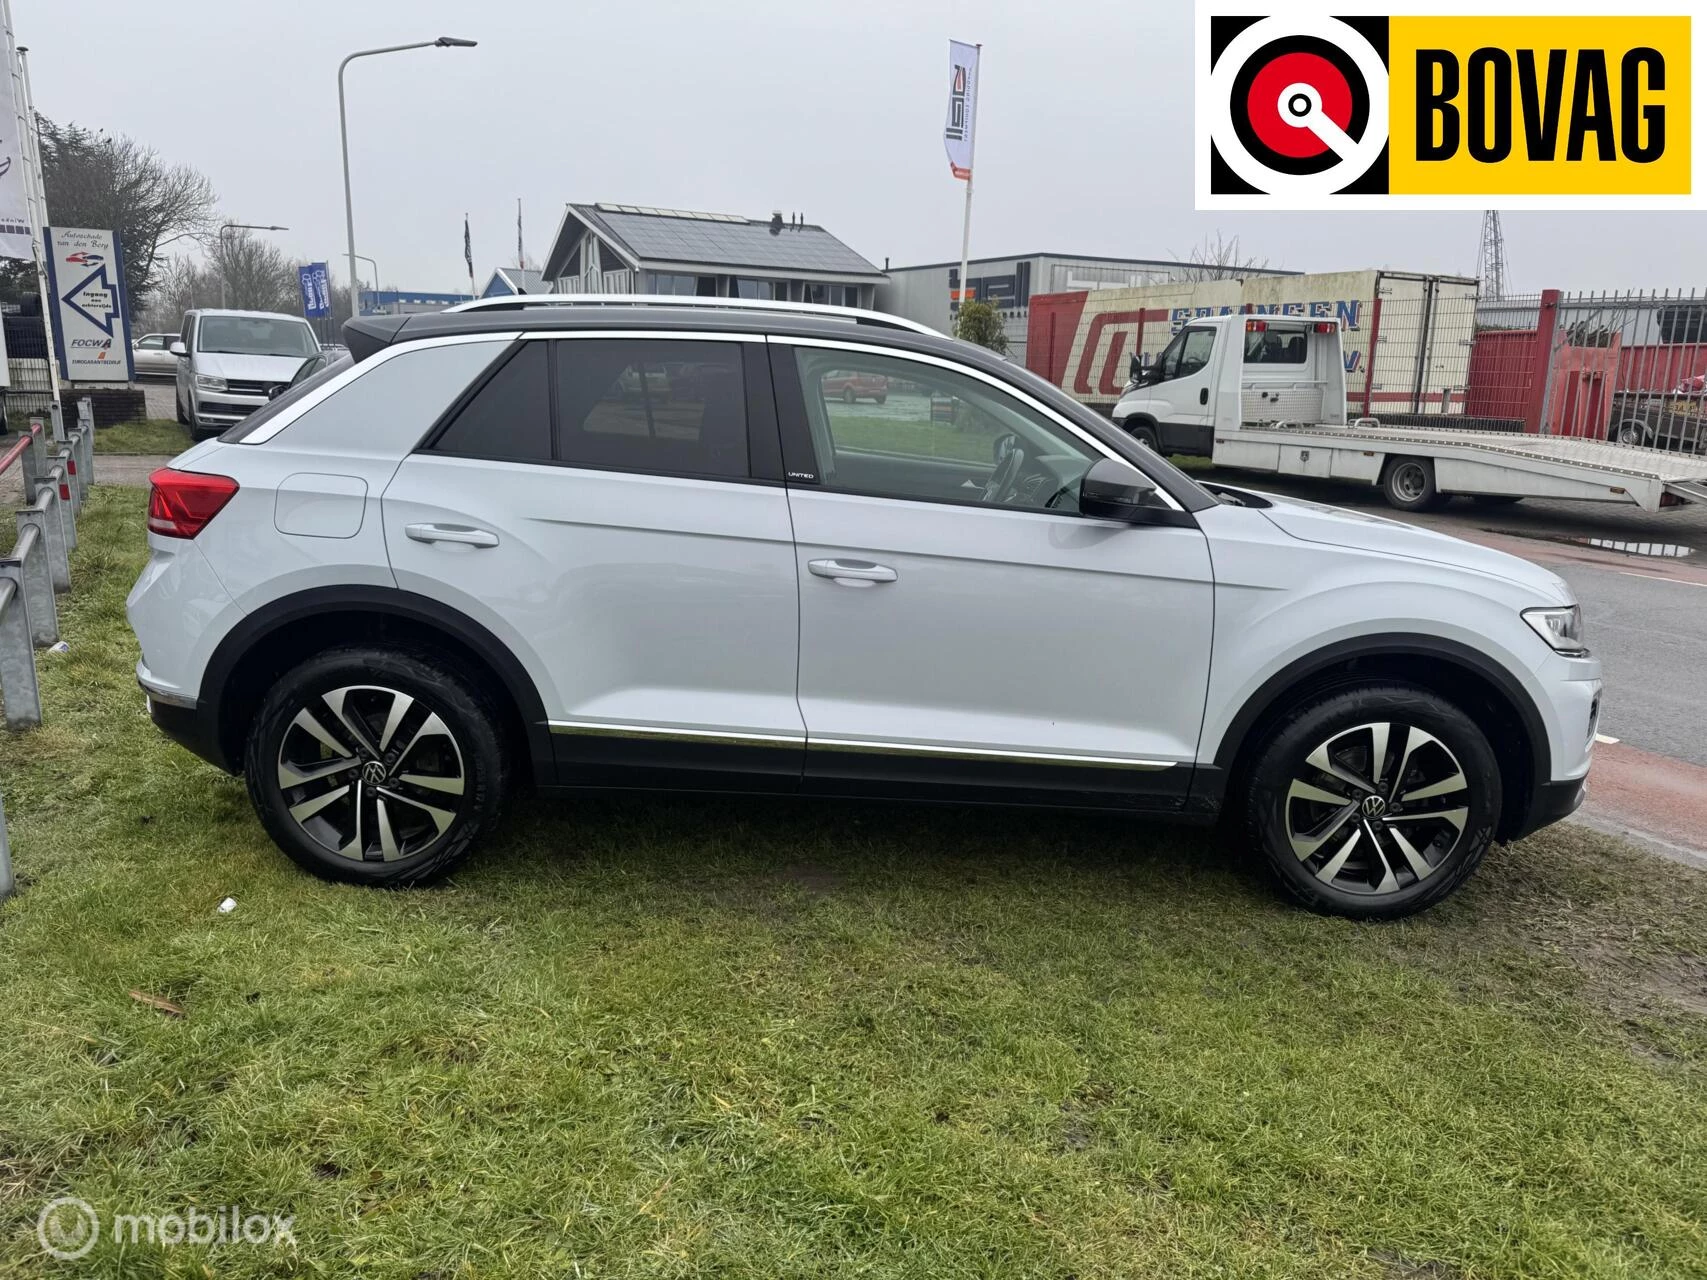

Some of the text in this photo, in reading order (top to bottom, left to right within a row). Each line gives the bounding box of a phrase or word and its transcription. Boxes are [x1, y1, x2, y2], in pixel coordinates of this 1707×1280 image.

[61, 230, 103, 240] Autoschade
[91, 240, 109, 250] Berg
[71, 338, 112, 349] FOCWA
[788, 471, 814, 479] UNITED
